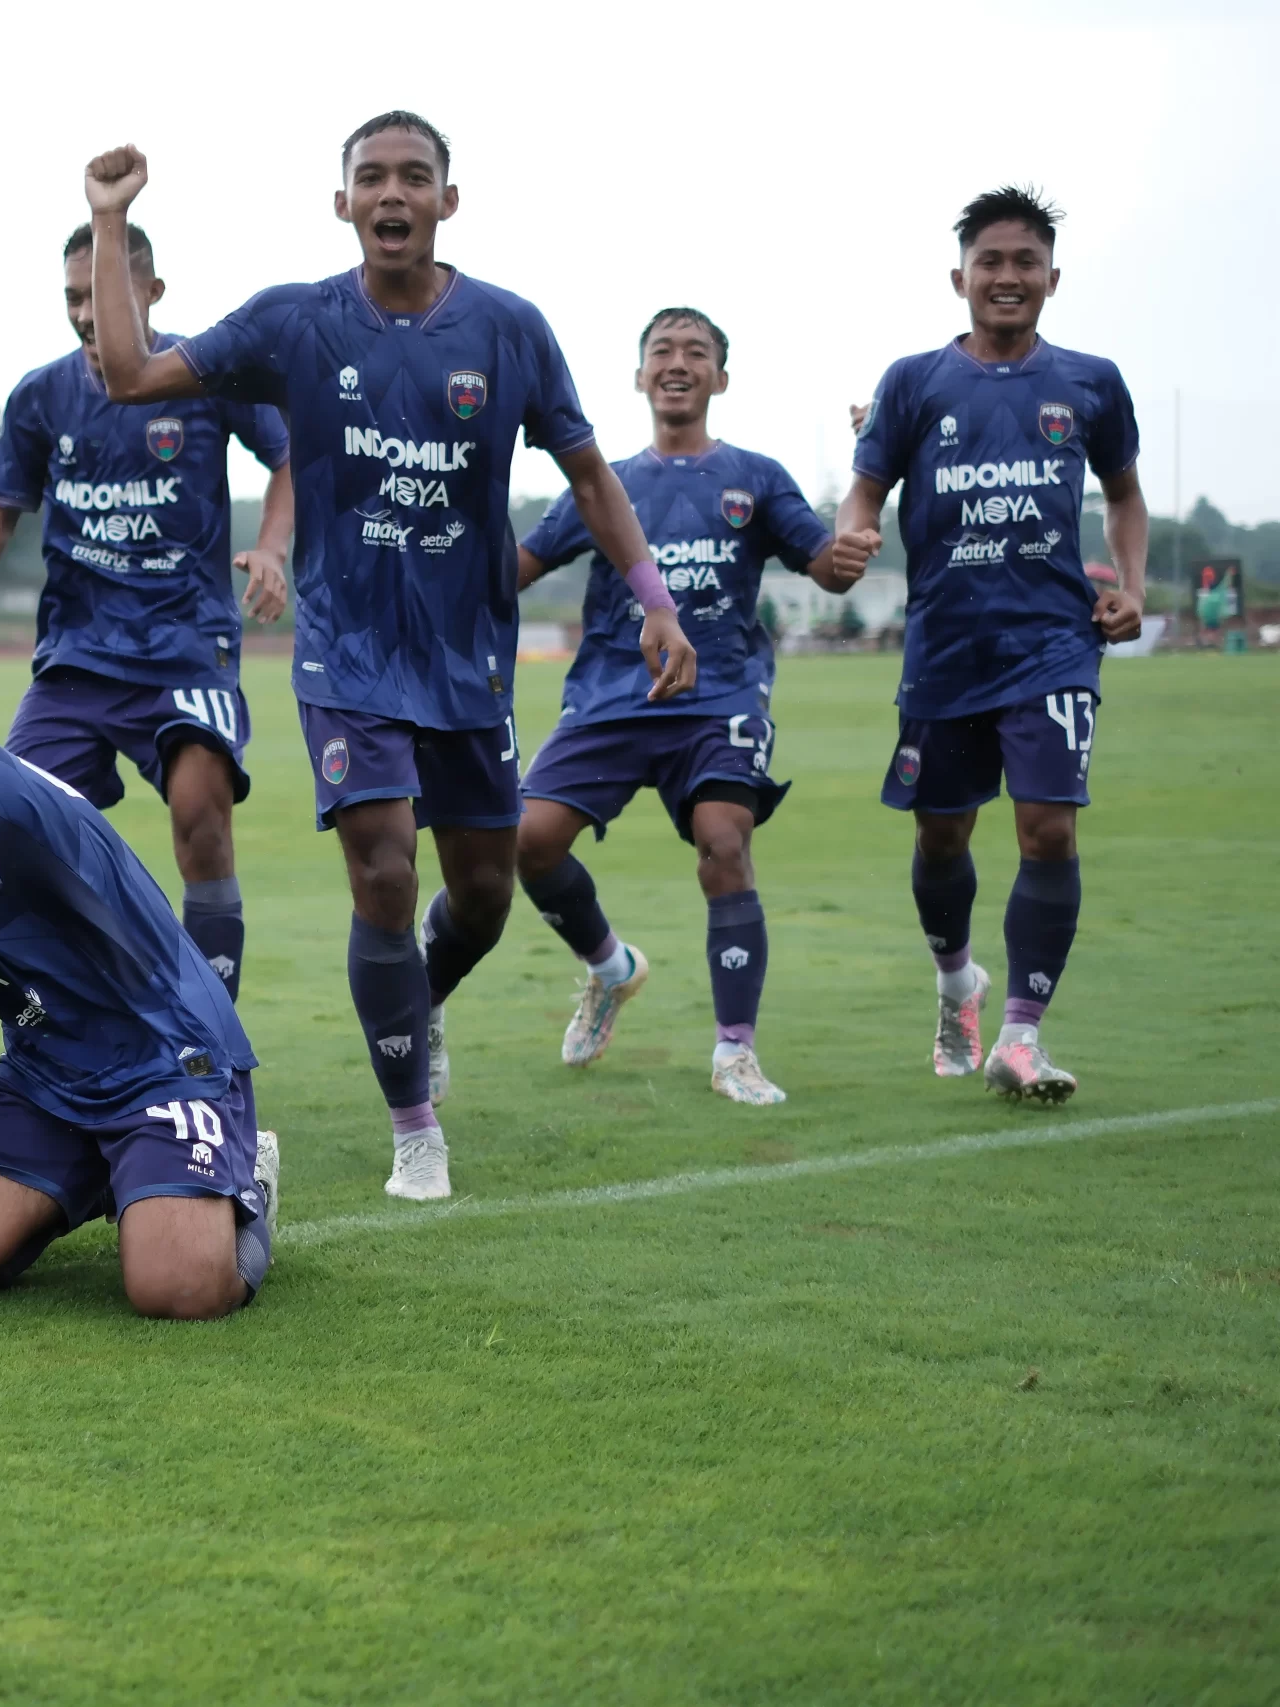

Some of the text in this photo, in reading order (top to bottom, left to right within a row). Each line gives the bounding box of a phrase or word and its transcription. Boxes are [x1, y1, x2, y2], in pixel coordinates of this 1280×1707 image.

[339, 392, 362, 401] MILLS
[451, 374, 484, 389] PERSITA
[344, 426, 470, 472] INDOMILK
[378, 472, 449, 508] MOYA
[935, 459, 1061, 494] INDOMILK
[55, 478, 179, 511] INDOMILK
[961, 494, 1043, 526] MOYA
[81, 513, 162, 542] MOYA
[420, 535, 453, 547] aetra
[1018, 542, 1051, 555] aetra
[172, 687, 237, 743] 40
[1046, 692, 1094, 750] 43
[145, 1099, 224, 1147] 40
[187, 1163, 215, 1177] MILLS
